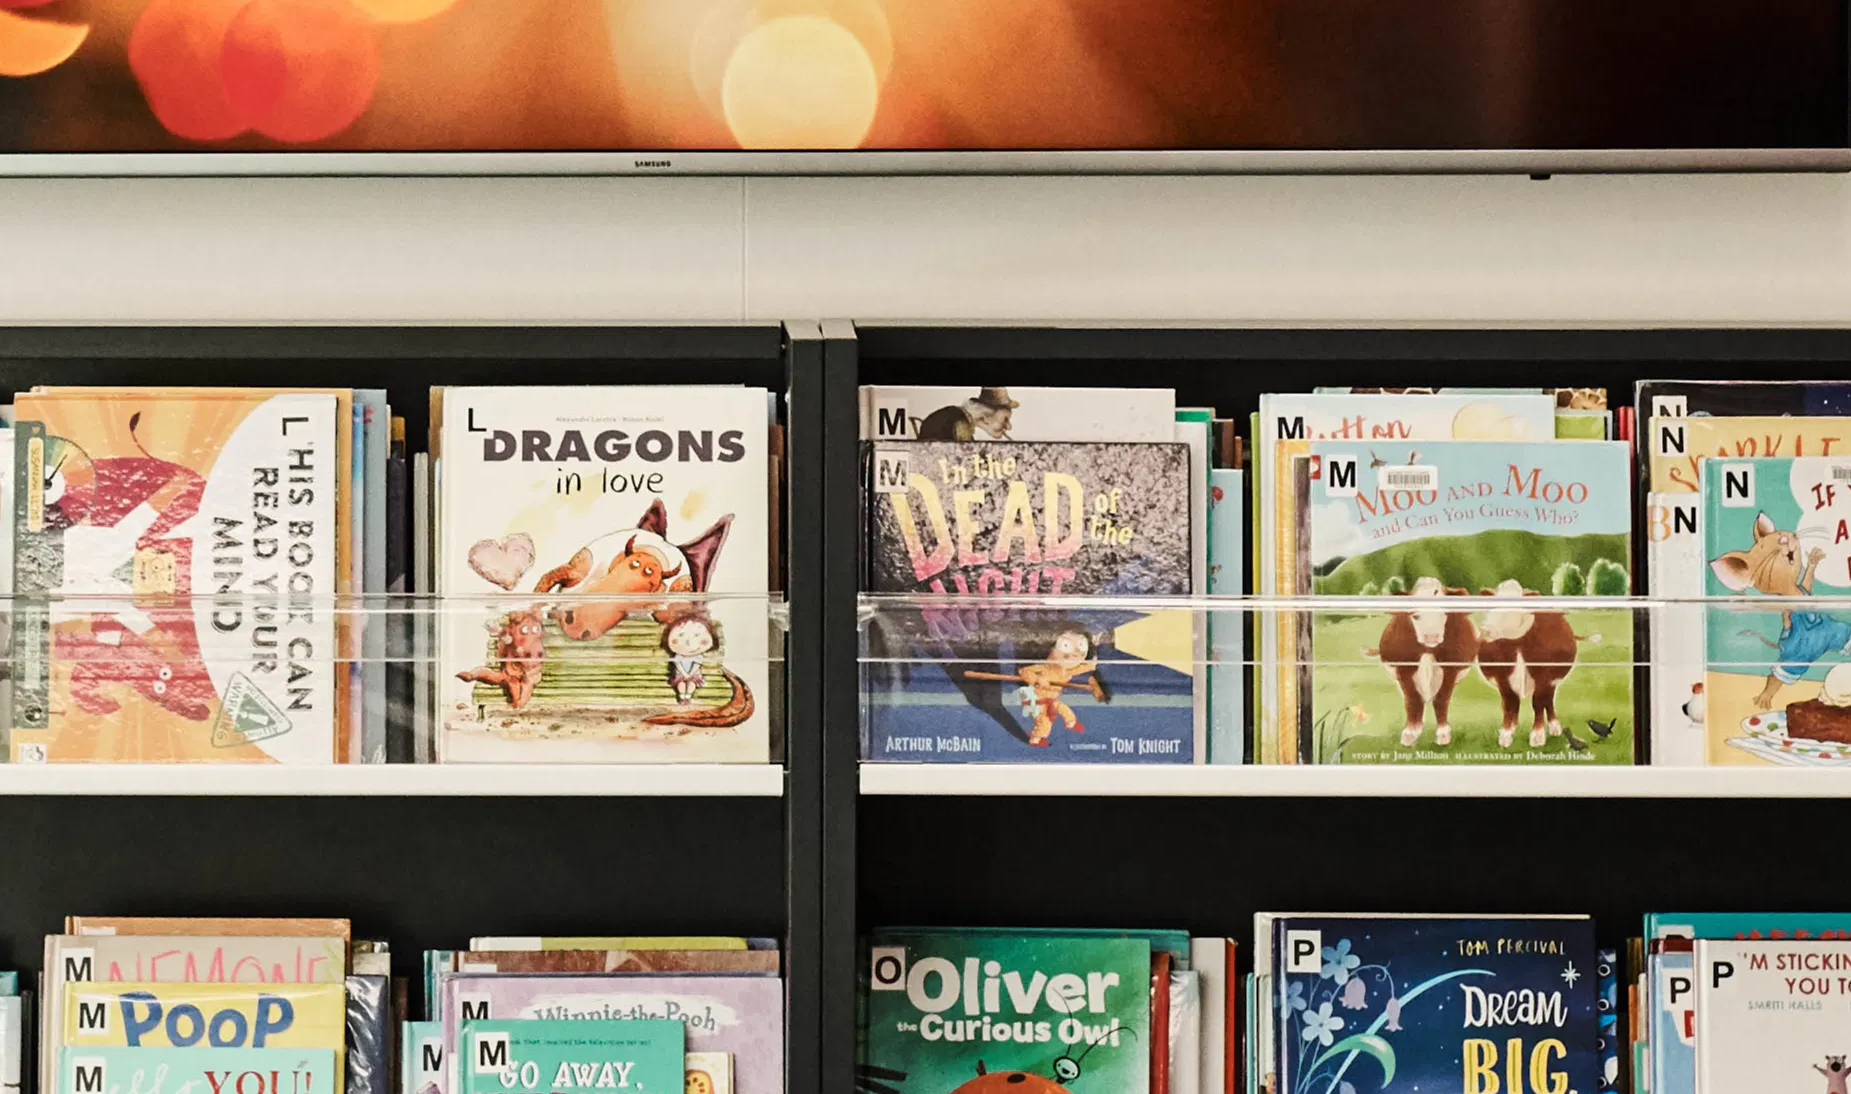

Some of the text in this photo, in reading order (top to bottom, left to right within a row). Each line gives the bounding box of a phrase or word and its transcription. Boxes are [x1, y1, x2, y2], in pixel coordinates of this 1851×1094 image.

[878, 408, 907, 436] M
[483, 428, 746, 463] DRAGONS
[1661, 427, 1685, 454] N
[556, 466, 664, 495] in love
[971, 452, 1017, 481] the
[1503, 463, 1589, 505] Moo
[1725, 471, 1749, 499] N
[1092, 488, 1123, 516] of
[892, 470, 1086, 583] DEAD
[1090, 511, 1134, 547] the
[1404, 507, 1474, 529] Can You
[1834, 518, 1850, 545] A
[885, 737, 933, 753] ARTHUR
[1110, 738, 1134, 753] TOM
[1138, 738, 1181, 755] KNIGHT
[1457, 939, 1490, 957] TOM
[905, 955, 1121, 1016] Oliver
[1713, 961, 1735, 989] P
[1784, 976, 1833, 996] YOU
[897, 1014, 1121, 1047] the Curious Owl
[480, 1041, 507, 1067] M
